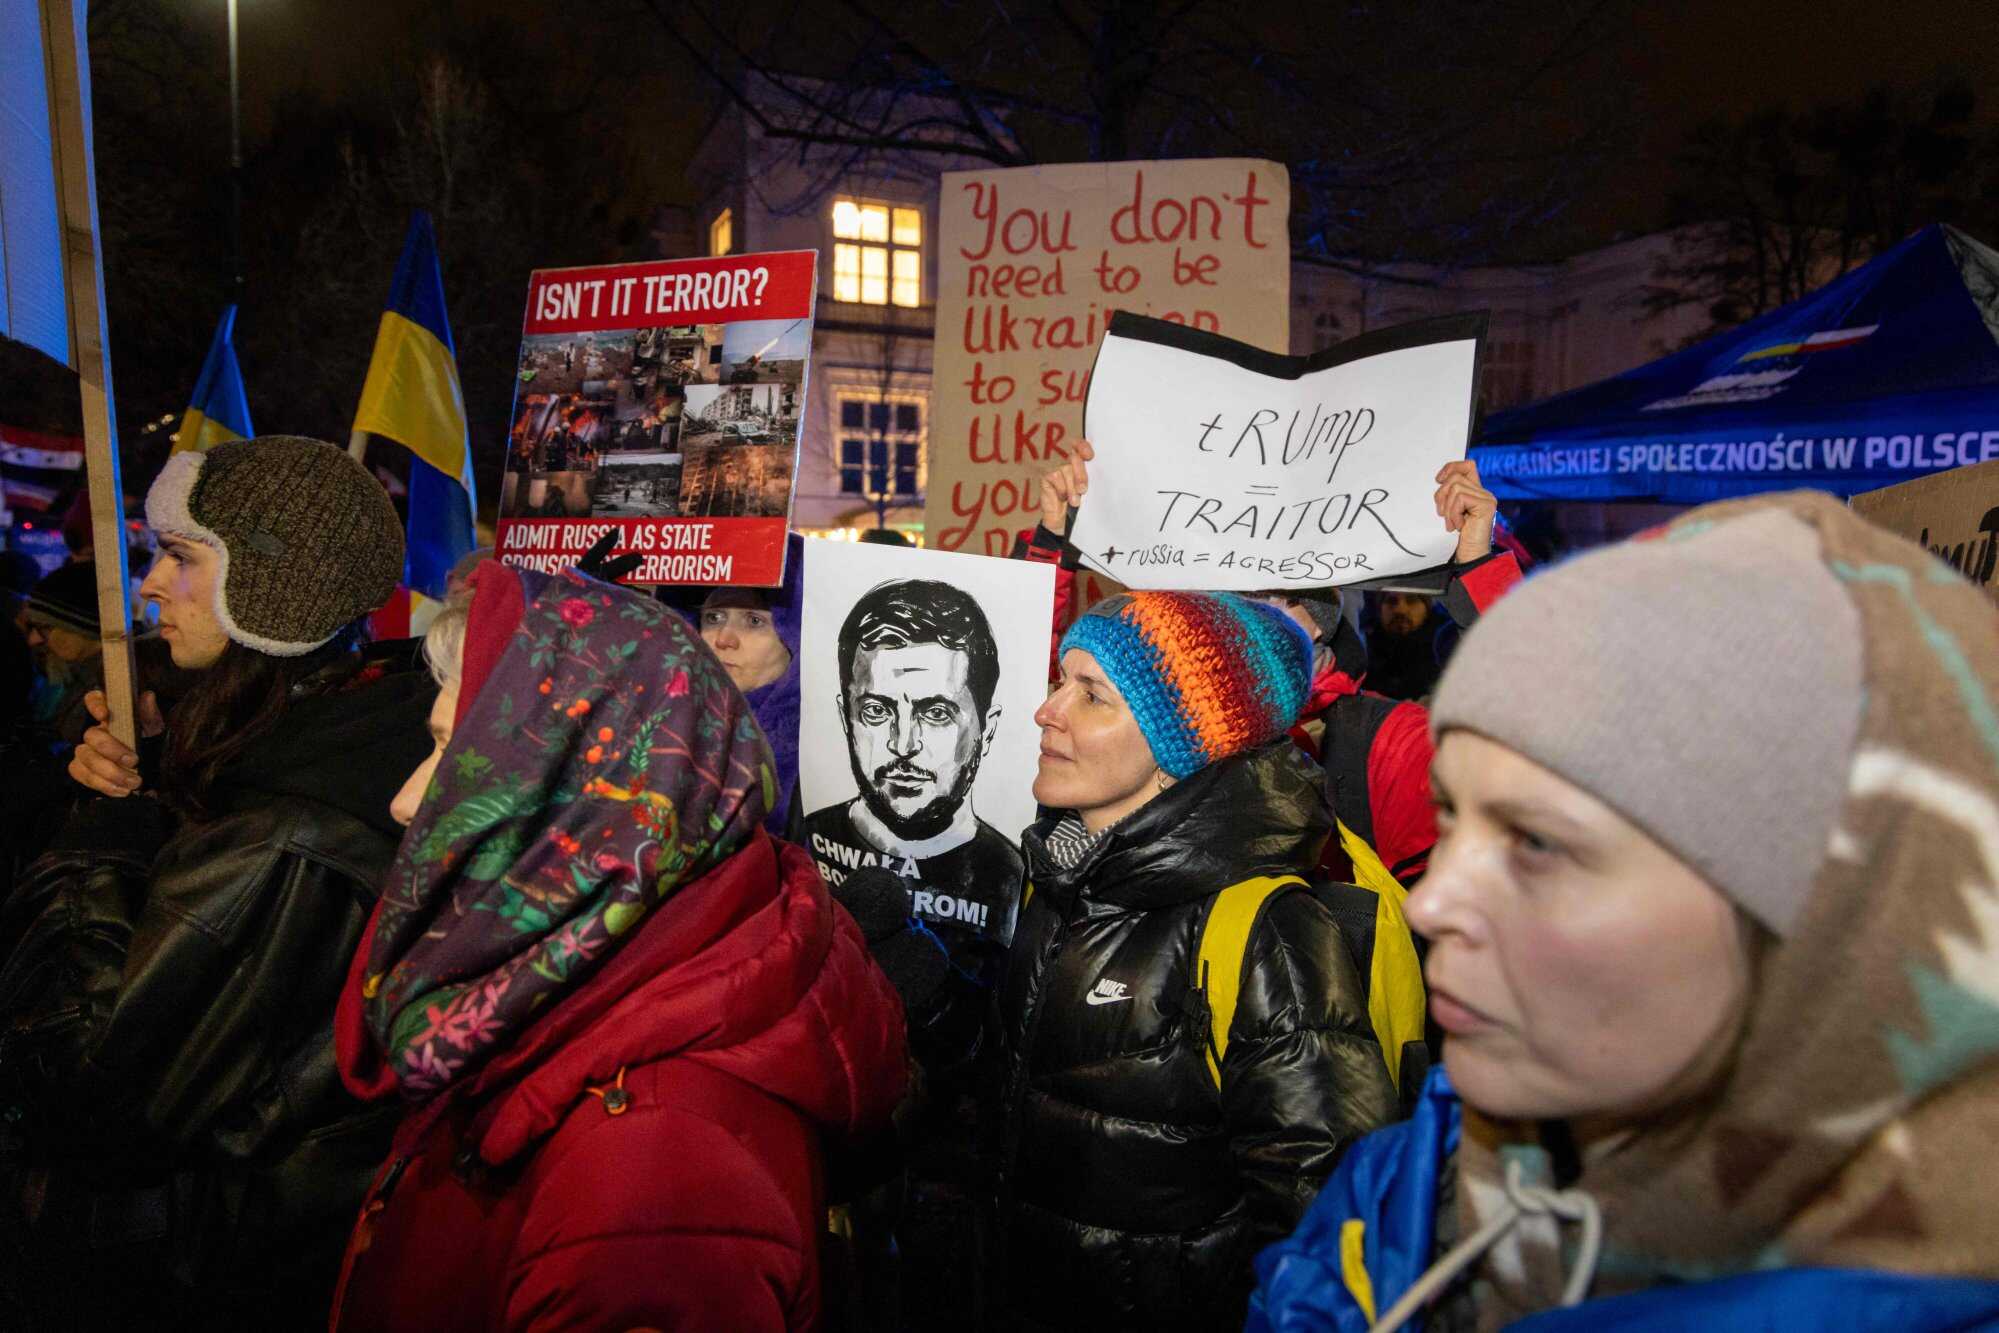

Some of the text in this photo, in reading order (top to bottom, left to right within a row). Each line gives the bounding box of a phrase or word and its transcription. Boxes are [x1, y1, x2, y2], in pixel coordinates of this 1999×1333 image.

[960, 169, 1271, 261] You don't
[535, 267, 769, 321] ISN'T IT TERROR?
[967, 247, 1221, 298] need to be
[963, 362, 1016, 405] to
[1617, 432, 1813, 473] SPOŁECZNOŚCI
[1822, 437, 1858, 470] W
[1864, 430, 1999, 470] POLSCE
[503, 524, 714, 550] ADMIT RUSSA AS STATE
[1157, 488, 1427, 558] TRAITOR
[1094, 978, 1128, 997] NIKE
